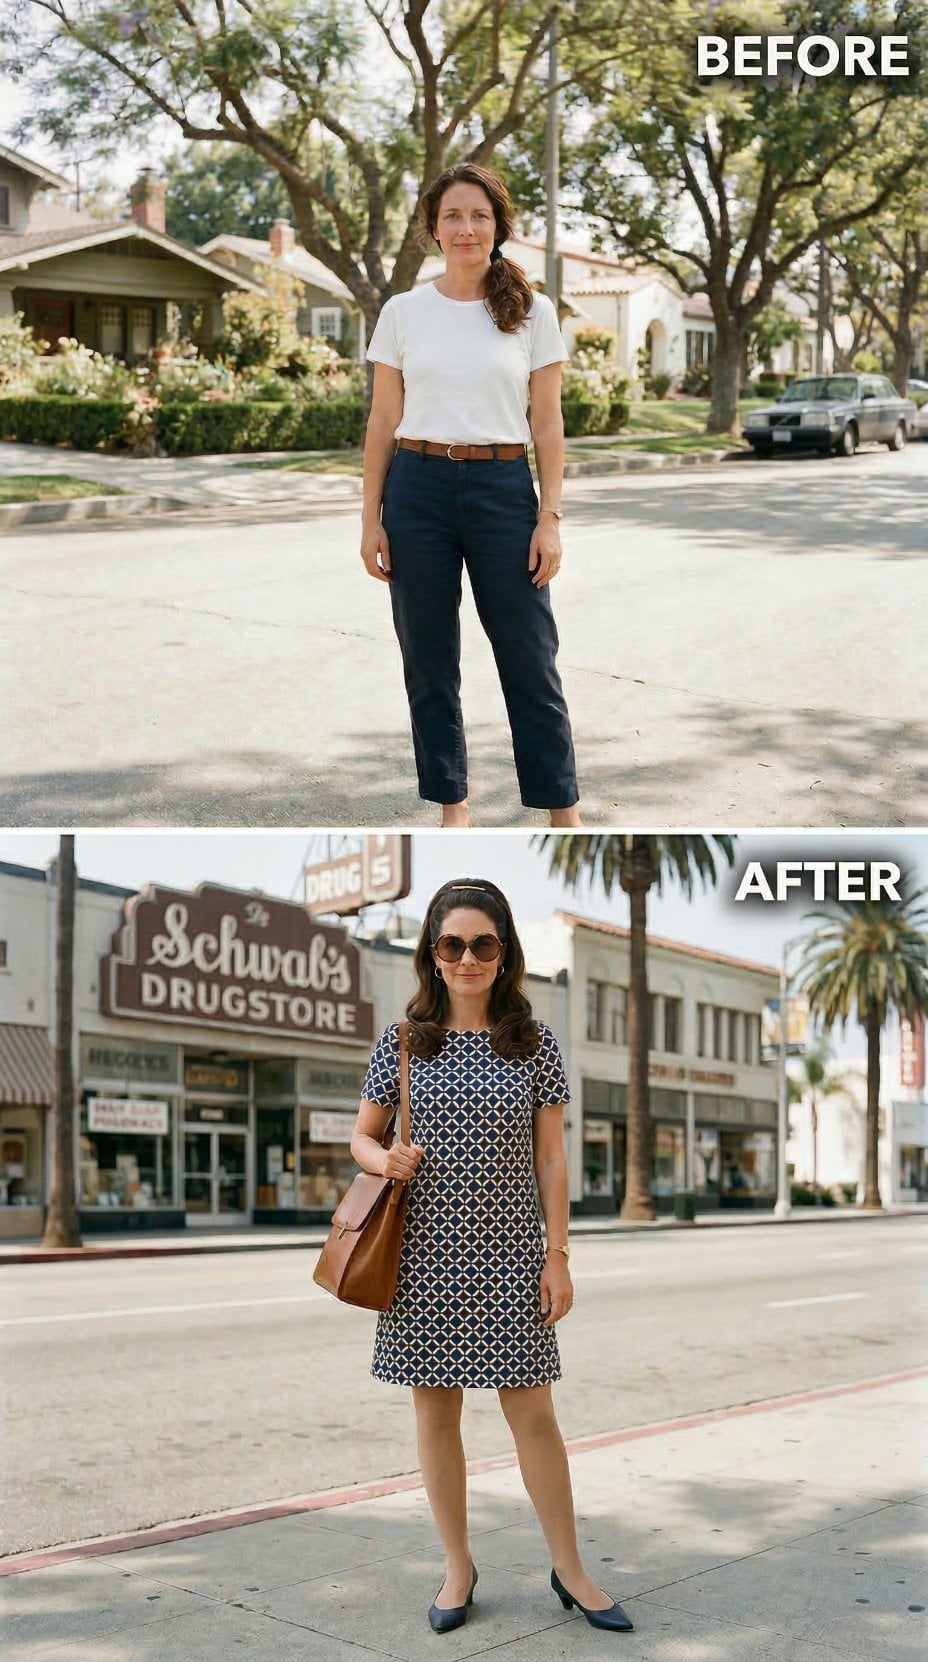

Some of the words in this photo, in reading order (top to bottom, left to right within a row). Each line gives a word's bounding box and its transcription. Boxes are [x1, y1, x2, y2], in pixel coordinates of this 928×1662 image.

[305, 861, 362, 904] DRUG
[145, 902, 351, 994] Schwab's
[141, 972, 356, 1032] DRUGSTORE
